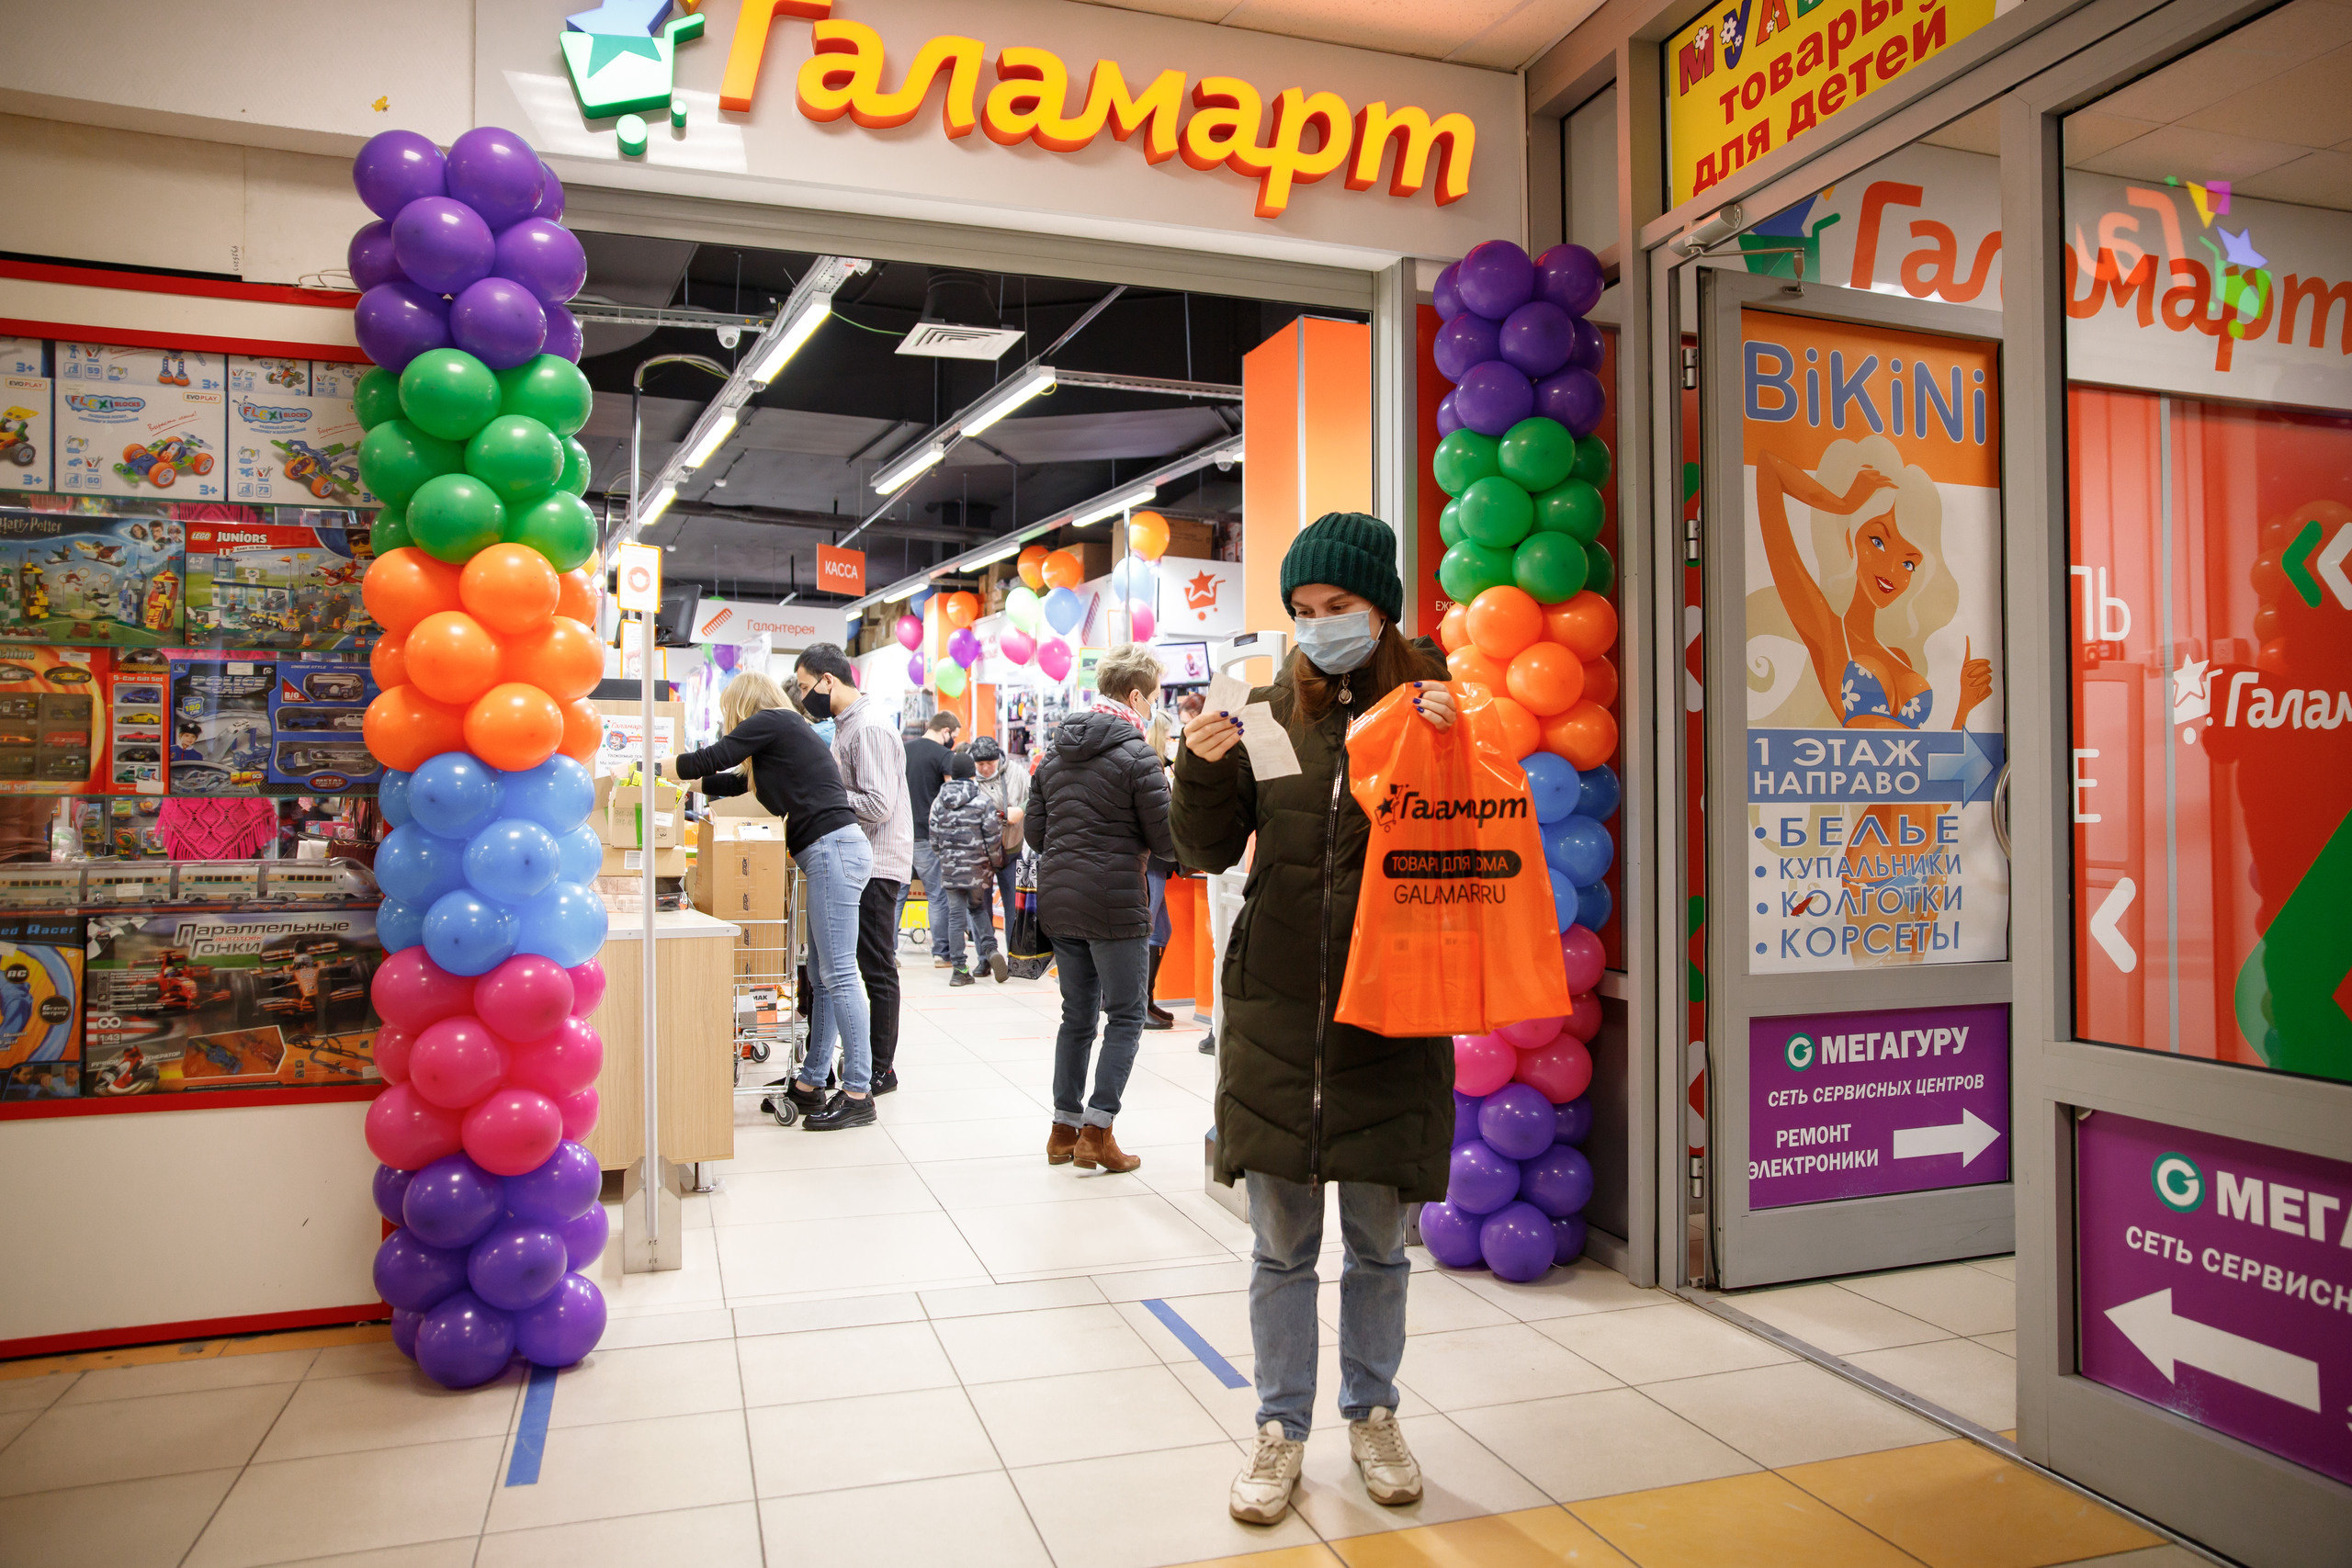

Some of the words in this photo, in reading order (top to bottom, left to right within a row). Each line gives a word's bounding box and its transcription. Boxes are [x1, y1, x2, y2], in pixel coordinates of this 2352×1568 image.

[719, 0, 1476, 219] Галамарт
[1692, 117, 1771, 197] для
[1787, 0, 1947, 141] детей
[202, 378, 220, 389] 3+
[243, 406, 283, 421] FLEXI
[23, 474, 43, 485] 3+
[199, 485, 218, 495] 3+
[191, 532, 211, 540] LEGO
[825, 560, 858, 581] КАССА
[747, 619, 816, 636] Галантерея
[190, 675, 267, 687] POLICE
[1754, 738, 1770, 766] 1
[1792, 738, 1922, 767] ЭТАЖ
[1753, 770, 1921, 795] НАПРАВО
[1780, 814, 1960, 849] БЕЛЬЕ
[1442, 855, 1471, 874] ДЛЯ
[1780, 853, 1962, 880] КУПАЛЬНИКИ
[1781, 885, 1962, 919] КОЛГОТКИ
[175, 922, 352, 946] Параллельные
[1781, 920, 1961, 959] КОРСЕТЫ
[1821, 1026, 1970, 1065] МЕГАГУРУ
[1768, 1089, 1809, 1108] СЕТЬ
[1813, 1079, 1912, 1104] СЕРВИСНЫХ
[1916, 1073, 1985, 1097] ЦЕНТРОВ
[1776, 1123, 1852, 1149] РЕМОНТ
[1748, 1148, 1880, 1181] ЭЛЕКТРОНИКИ
[2125, 1225, 2194, 1265] СЕТЬ
